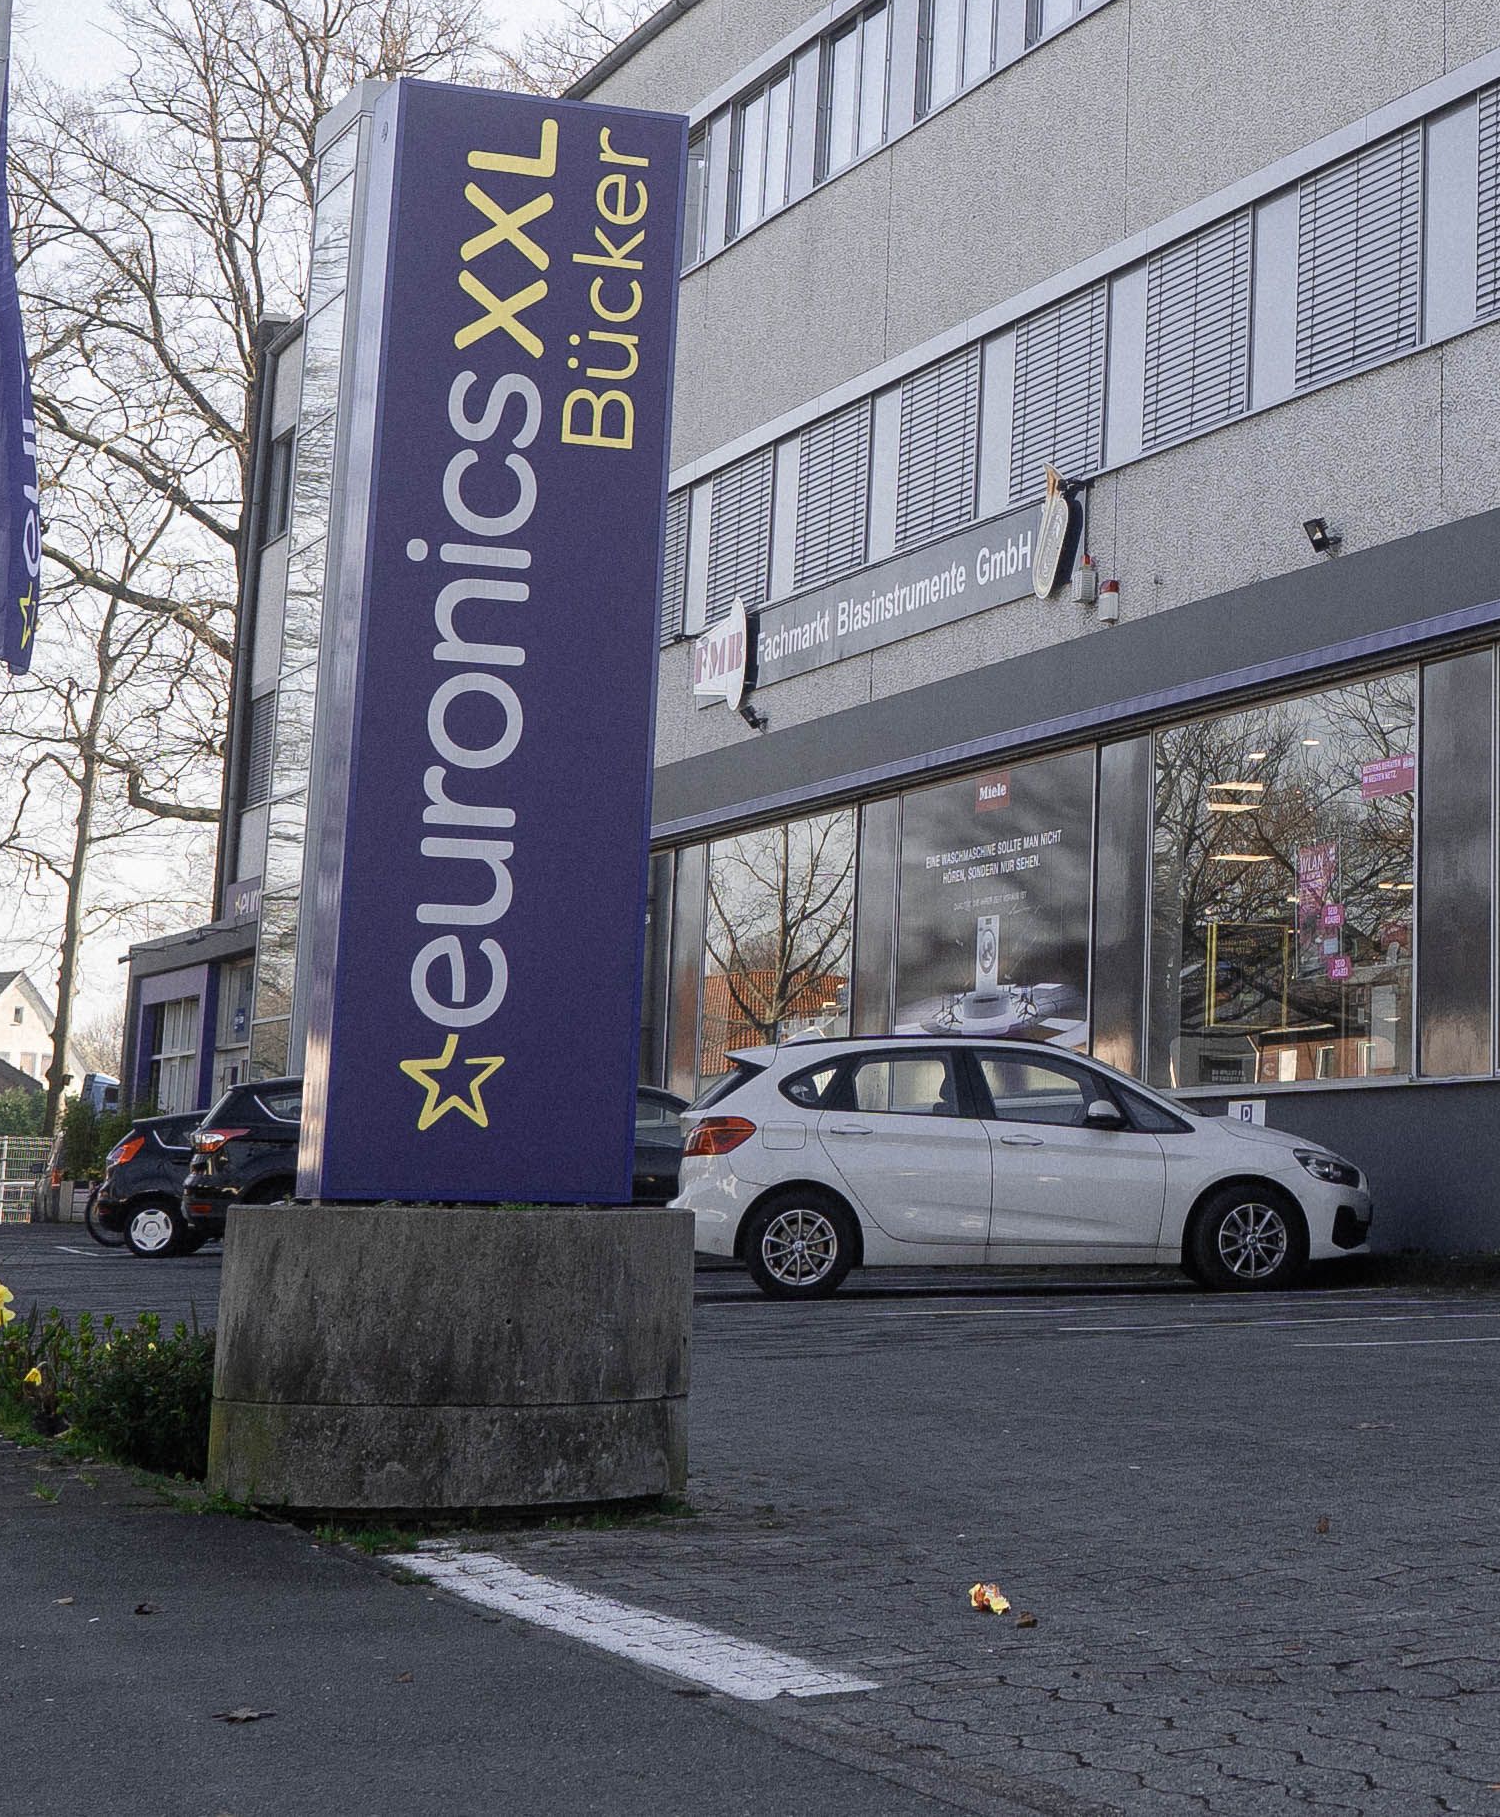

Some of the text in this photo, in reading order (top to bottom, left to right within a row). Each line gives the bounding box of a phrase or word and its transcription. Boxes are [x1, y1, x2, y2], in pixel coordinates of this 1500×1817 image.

[561, 126, 649, 450] Bücker
[758, 531, 1032, 664] Fachmarkt Blasinstrumente GmbH
[695, 633, 743, 684] FMB
[979, 783, 1007, 801] Miele
[925, 830, 1062, 869] EINE WASCHMASCHINE SOLLTE MAN NICHT
[967, 864, 999, 880] SONDERN
[1000, 861, 1015, 874] NUR
[1016, 854, 1041, 870] SEHEN.
